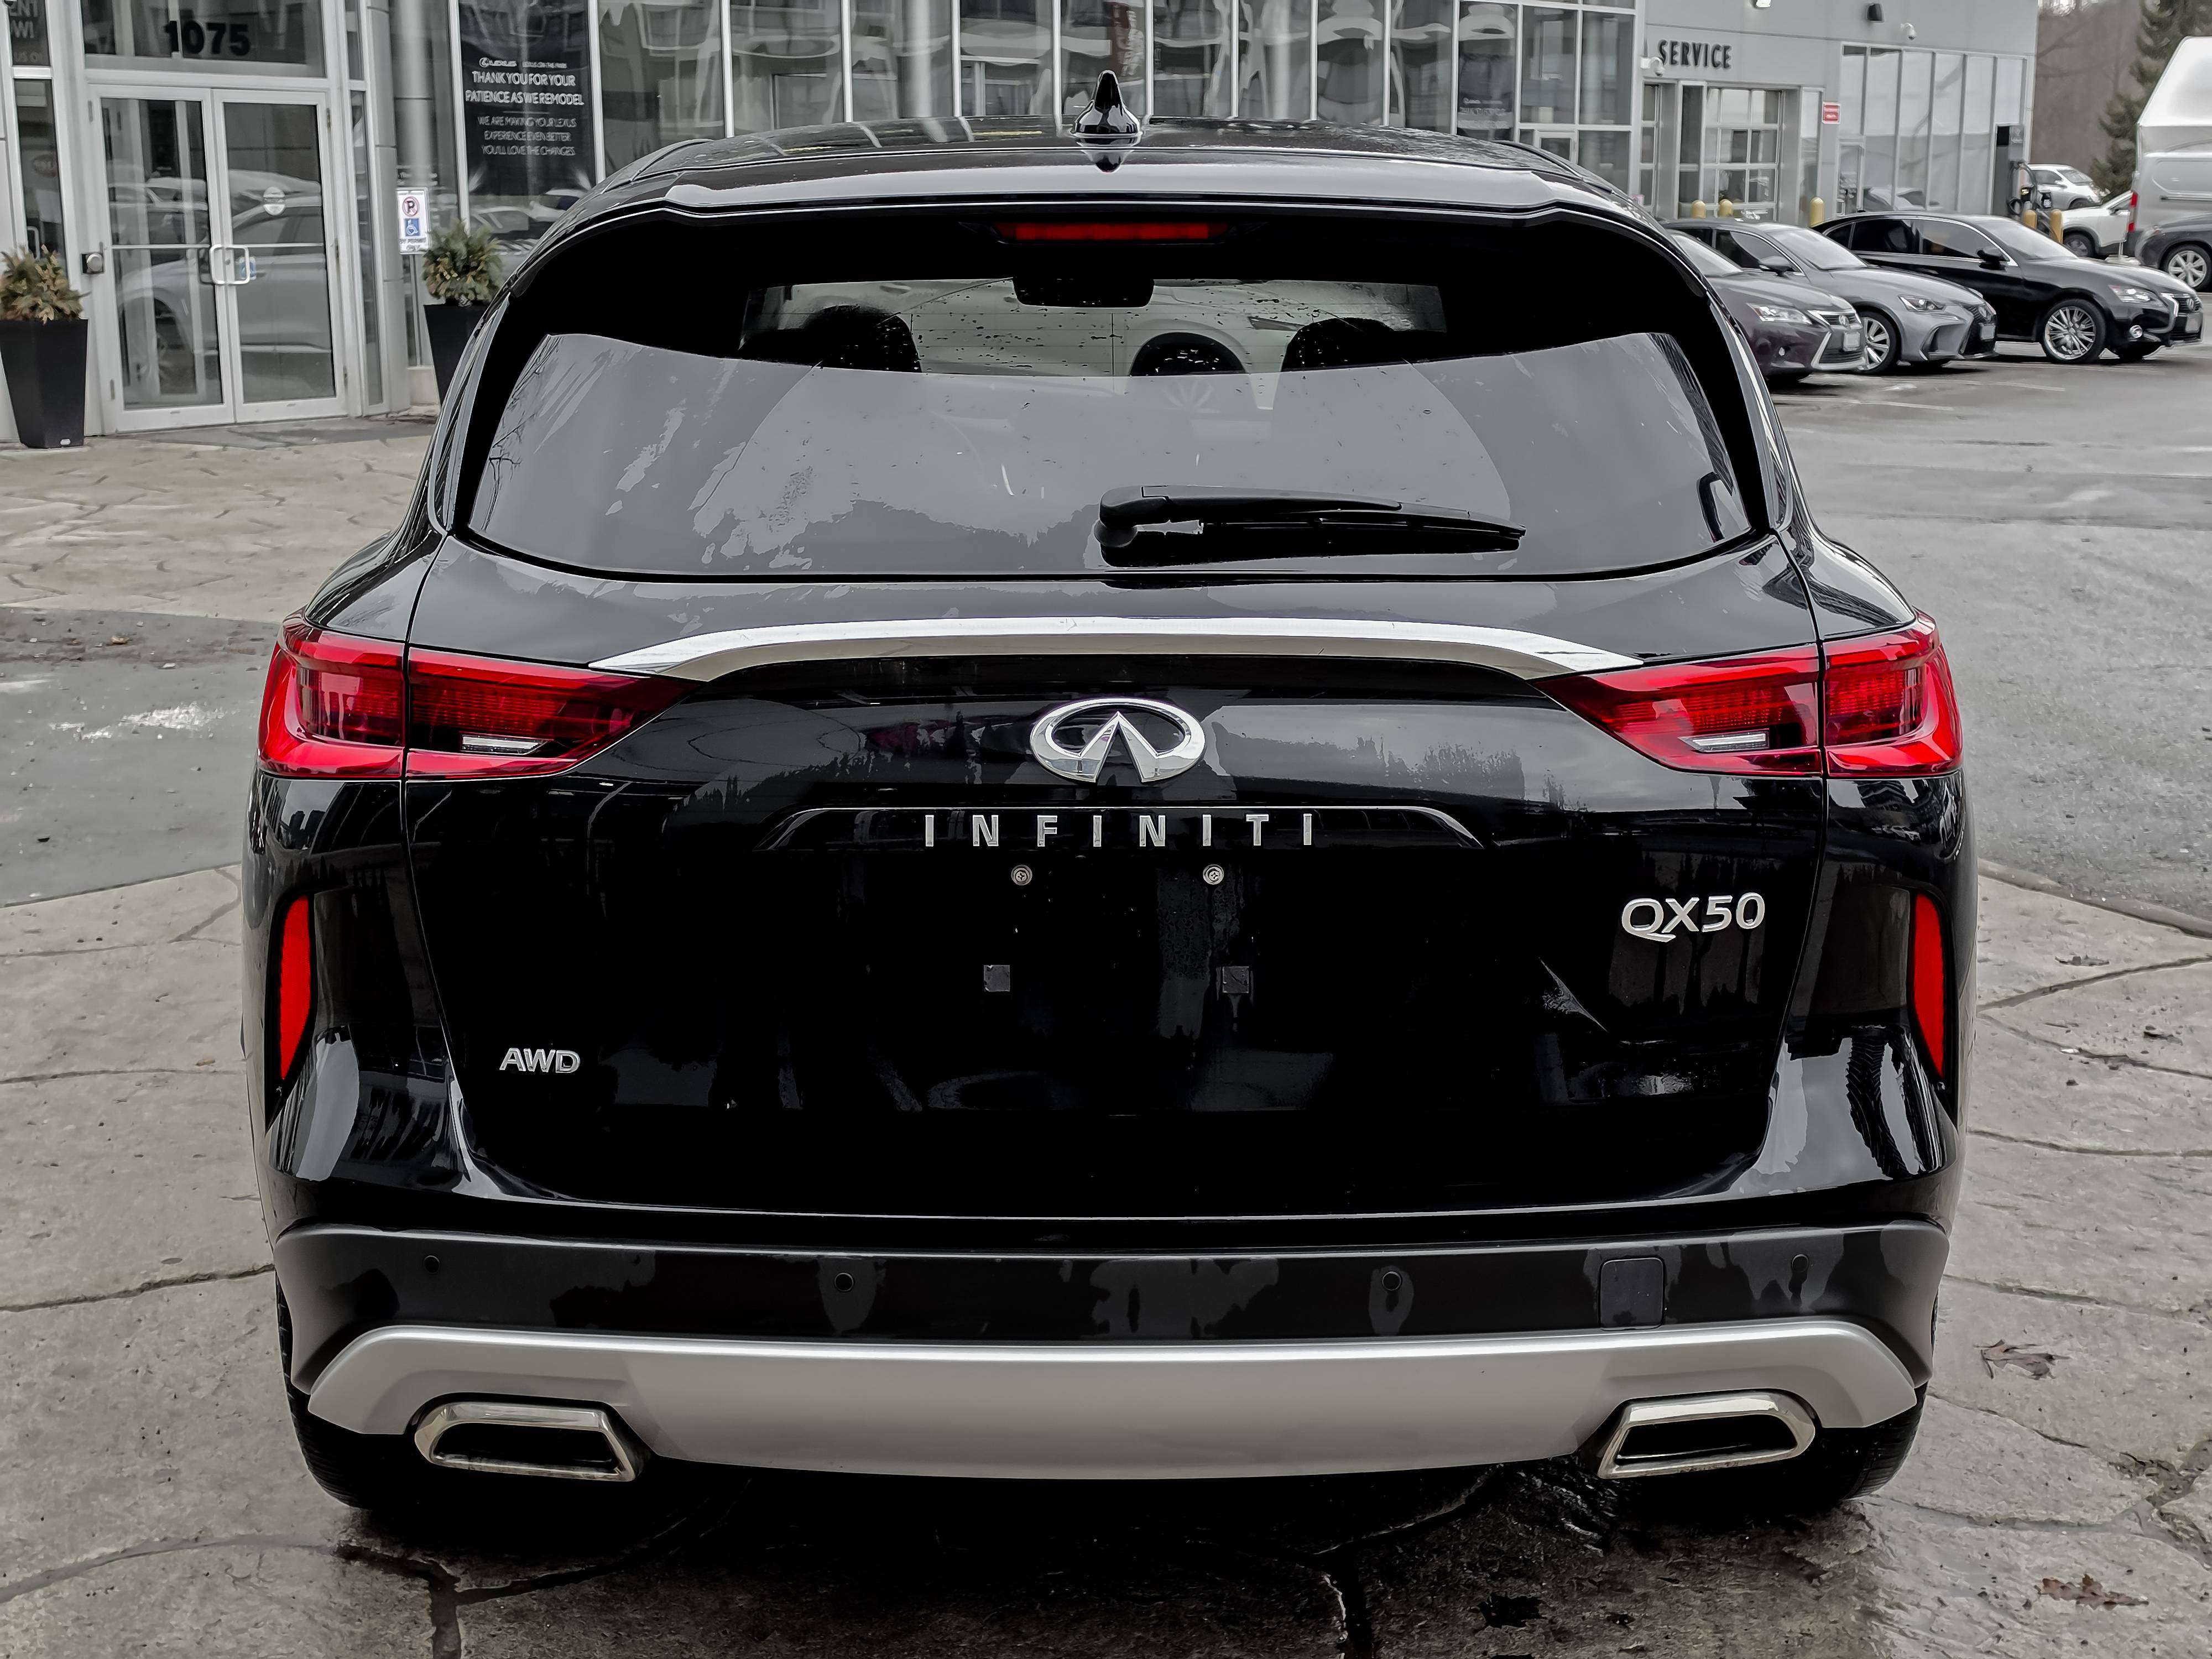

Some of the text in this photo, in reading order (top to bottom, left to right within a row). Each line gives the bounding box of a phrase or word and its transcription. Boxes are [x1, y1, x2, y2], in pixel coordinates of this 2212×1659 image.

[164, 20, 251, 56] 1075
[1658, 39, 1732, 69] SERVICE
[472, 71, 576, 86] THANK YOU FOR YOUR
[465, 90, 585, 105] PATIENCE AS WE REMODEL
[477, 116, 489, 126] WE
[491, 116, 504, 126] ARE
[925, 813, 1312, 847] INFINITI
[1621, 892, 1765, 942] QX50
[499, 1047, 581, 1073] AWD
